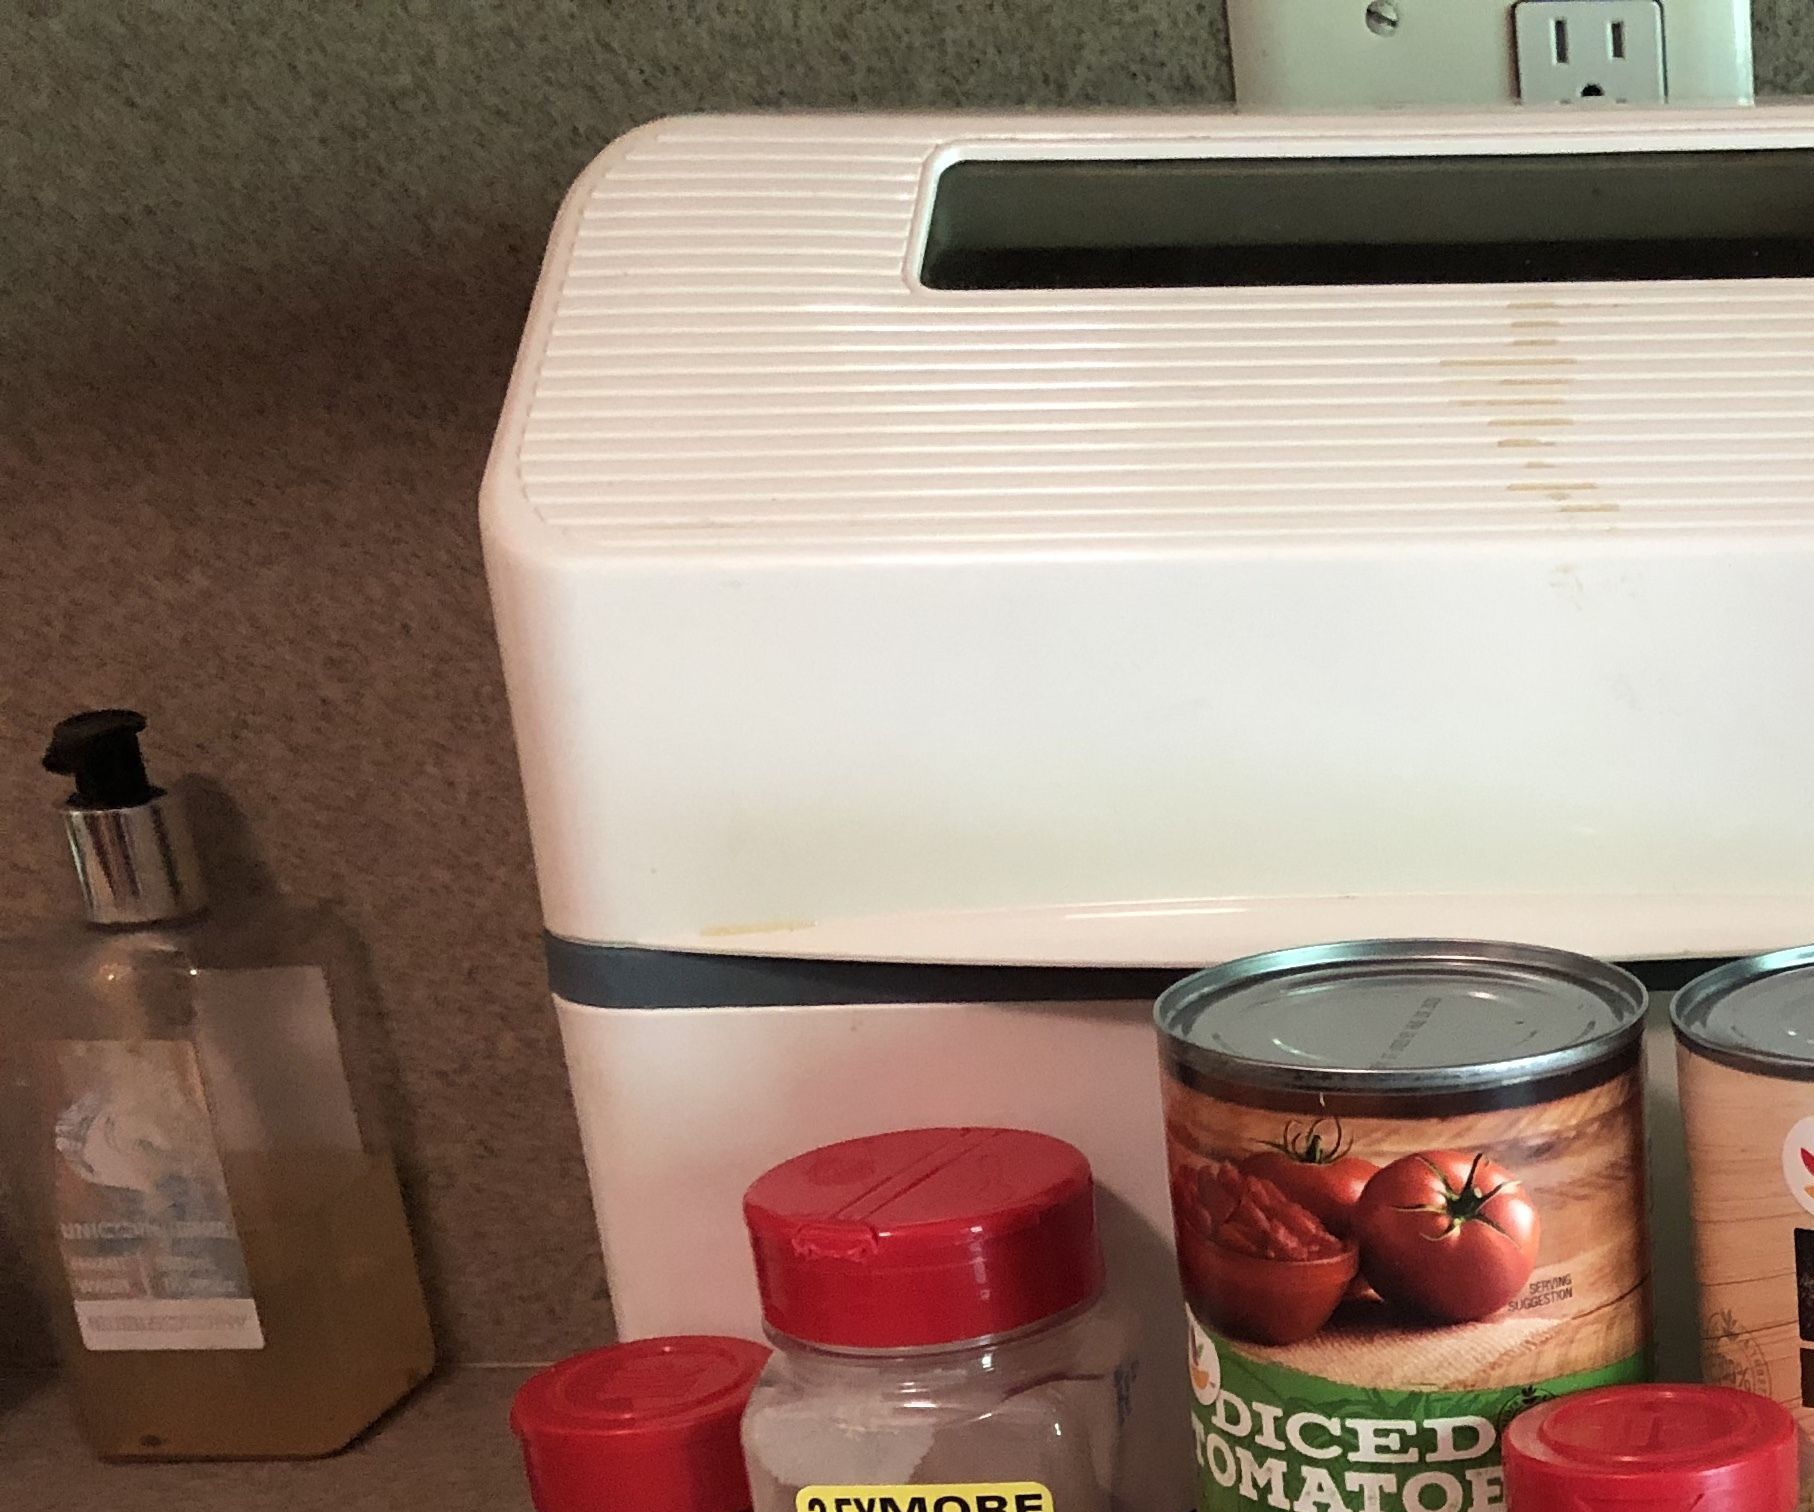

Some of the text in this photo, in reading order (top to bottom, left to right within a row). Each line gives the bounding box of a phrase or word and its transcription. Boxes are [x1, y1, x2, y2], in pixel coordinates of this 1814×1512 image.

[1529, 1274, 1572, 1294] SERVING
[1508, 1288, 1572, 1312] SUGGESTION
[1212, 1389, 1496, 1463] DICED
